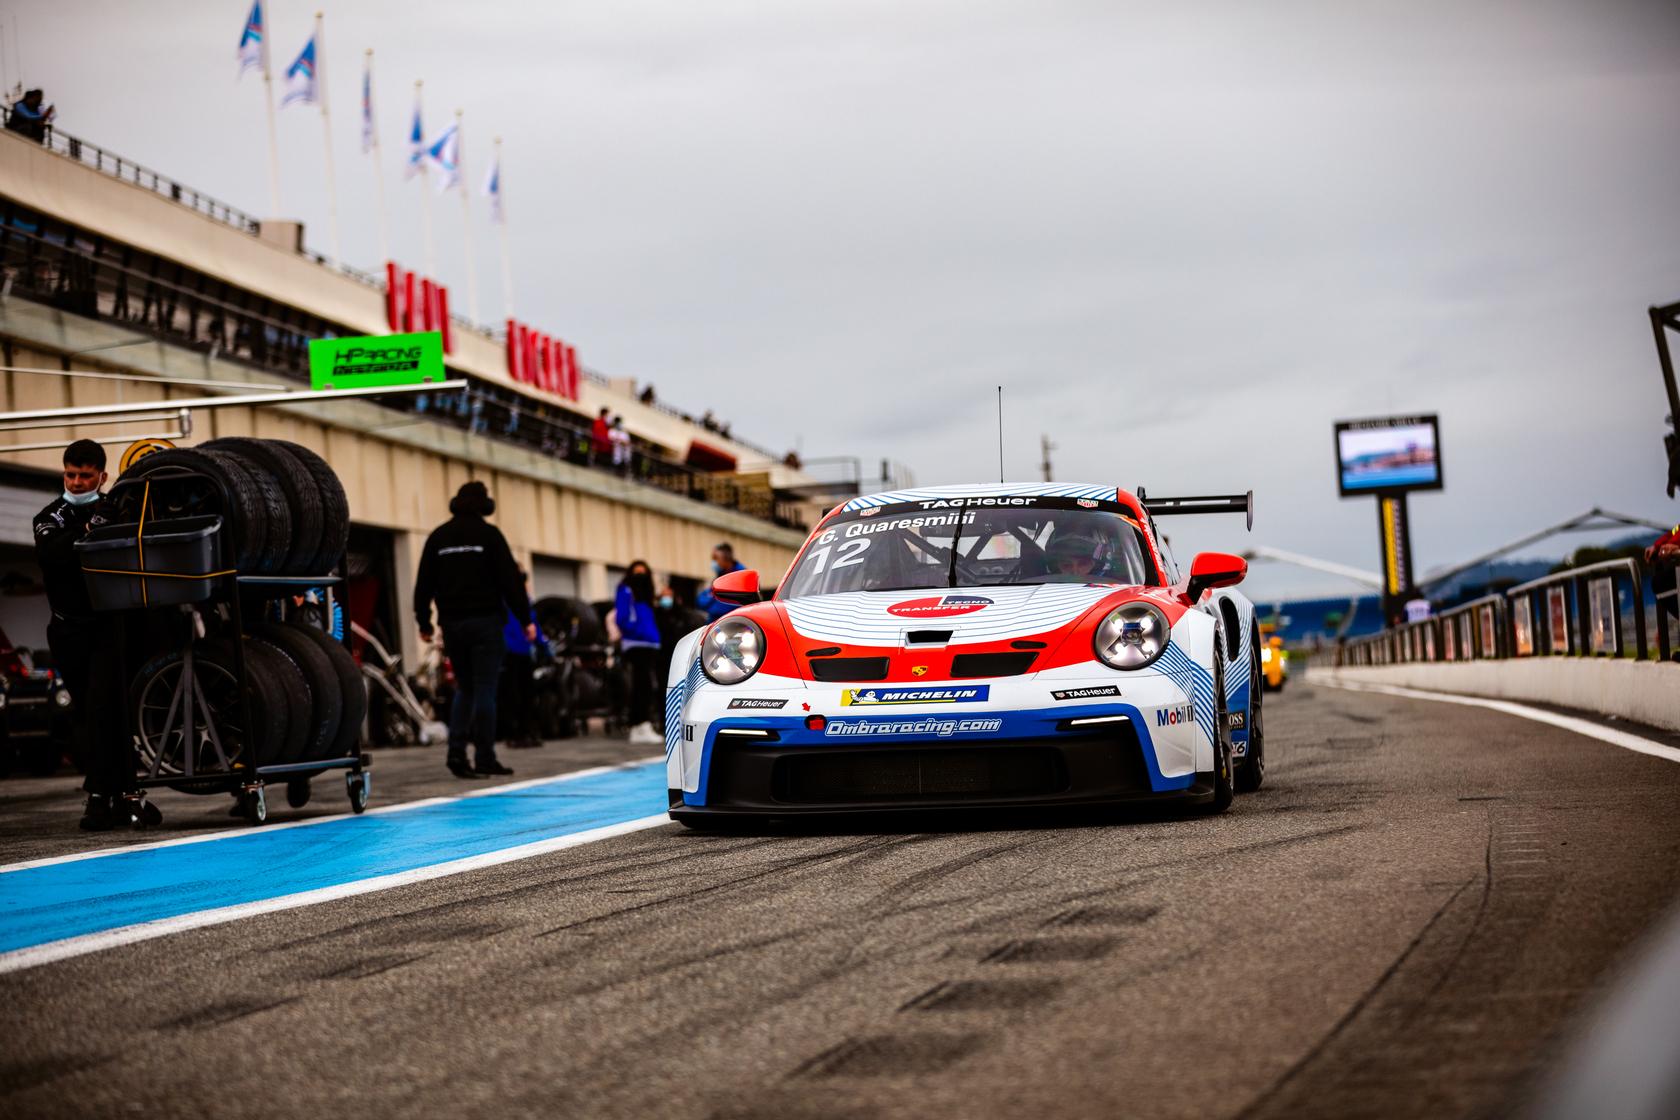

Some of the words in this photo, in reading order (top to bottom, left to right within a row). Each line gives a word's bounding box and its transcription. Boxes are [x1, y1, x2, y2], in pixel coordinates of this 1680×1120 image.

[819, 530, 839, 545] G.
[845, 512, 976, 537] Quaresmini
[807, 538, 872, 575] 12
[892, 605, 970, 613] TRANSFER
[882, 690, 977, 700] MICHELIN
[1157, 706, 1186, 727] Mobil
[825, 718, 1002, 736] Ombraracing.com
